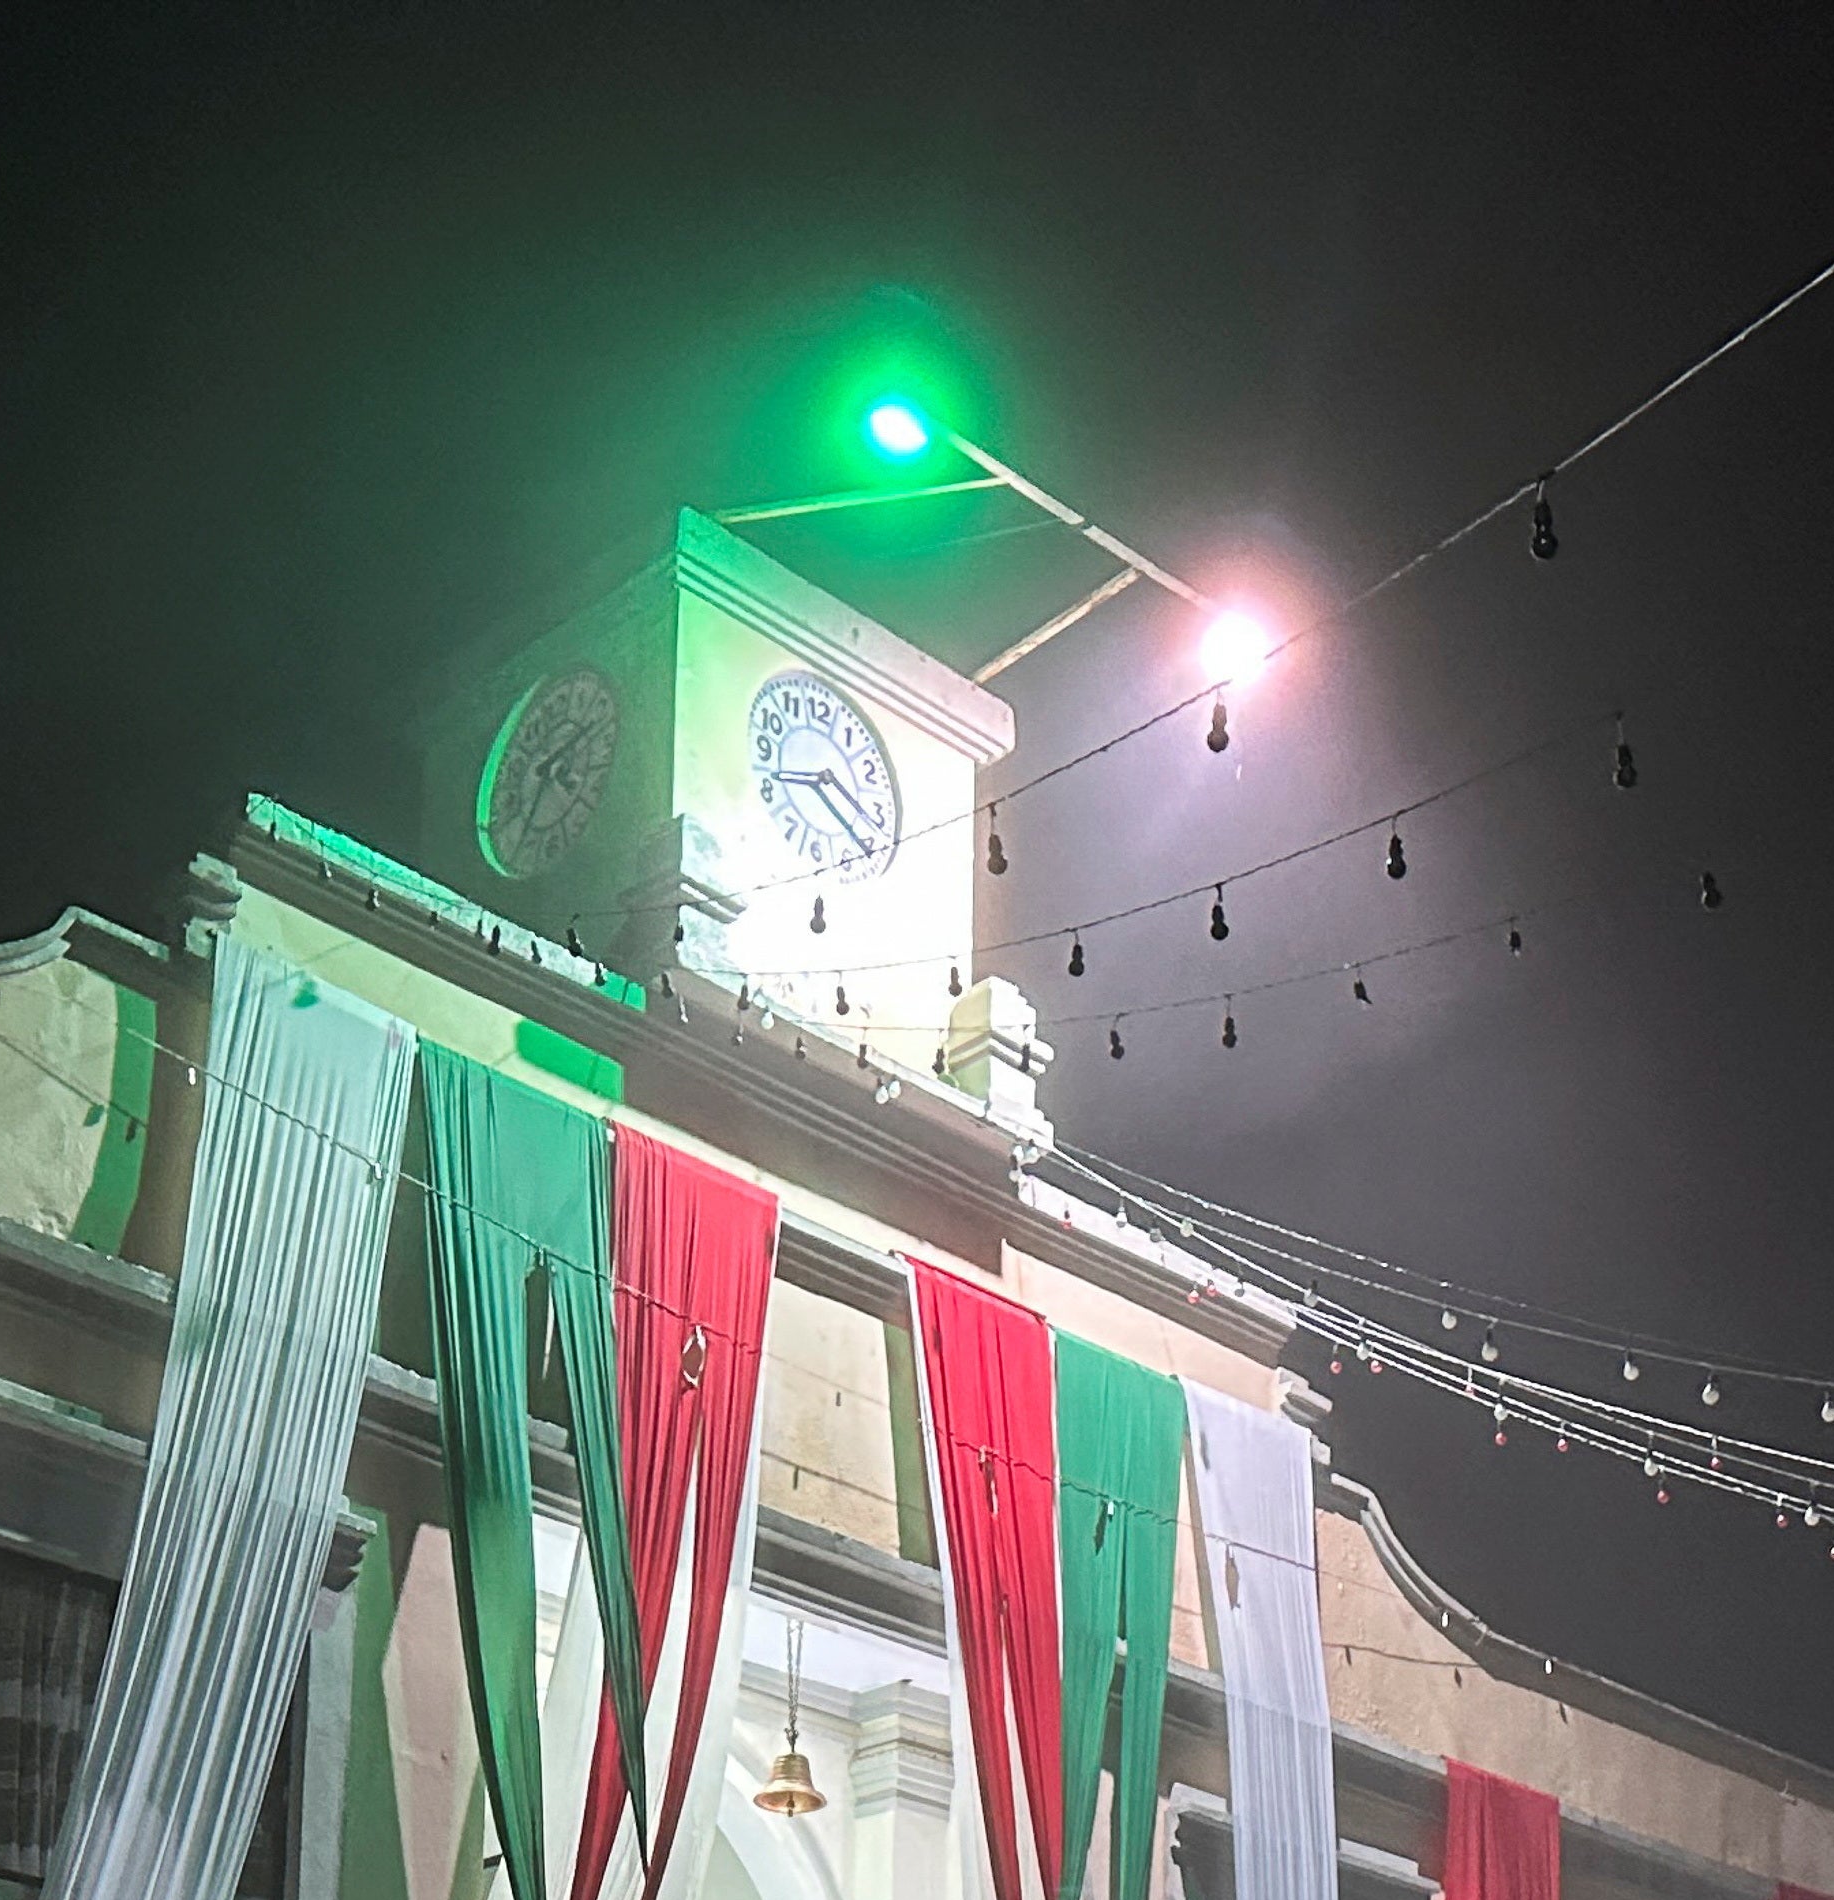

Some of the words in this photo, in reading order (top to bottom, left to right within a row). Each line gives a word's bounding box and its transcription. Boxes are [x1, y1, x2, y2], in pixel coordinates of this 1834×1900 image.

[782, 691, 799, 718] 11
[806, 697, 831, 727] 12
[761, 707, 782, 735] 10
[756, 734, 772, 761] 9
[844, 726, 852, 748] 1
[863, 759, 877, 785] 2
[760, 778, 773, 803] 8
[784, 815, 799, 842] 7
[810, 841, 822, 862] 6
